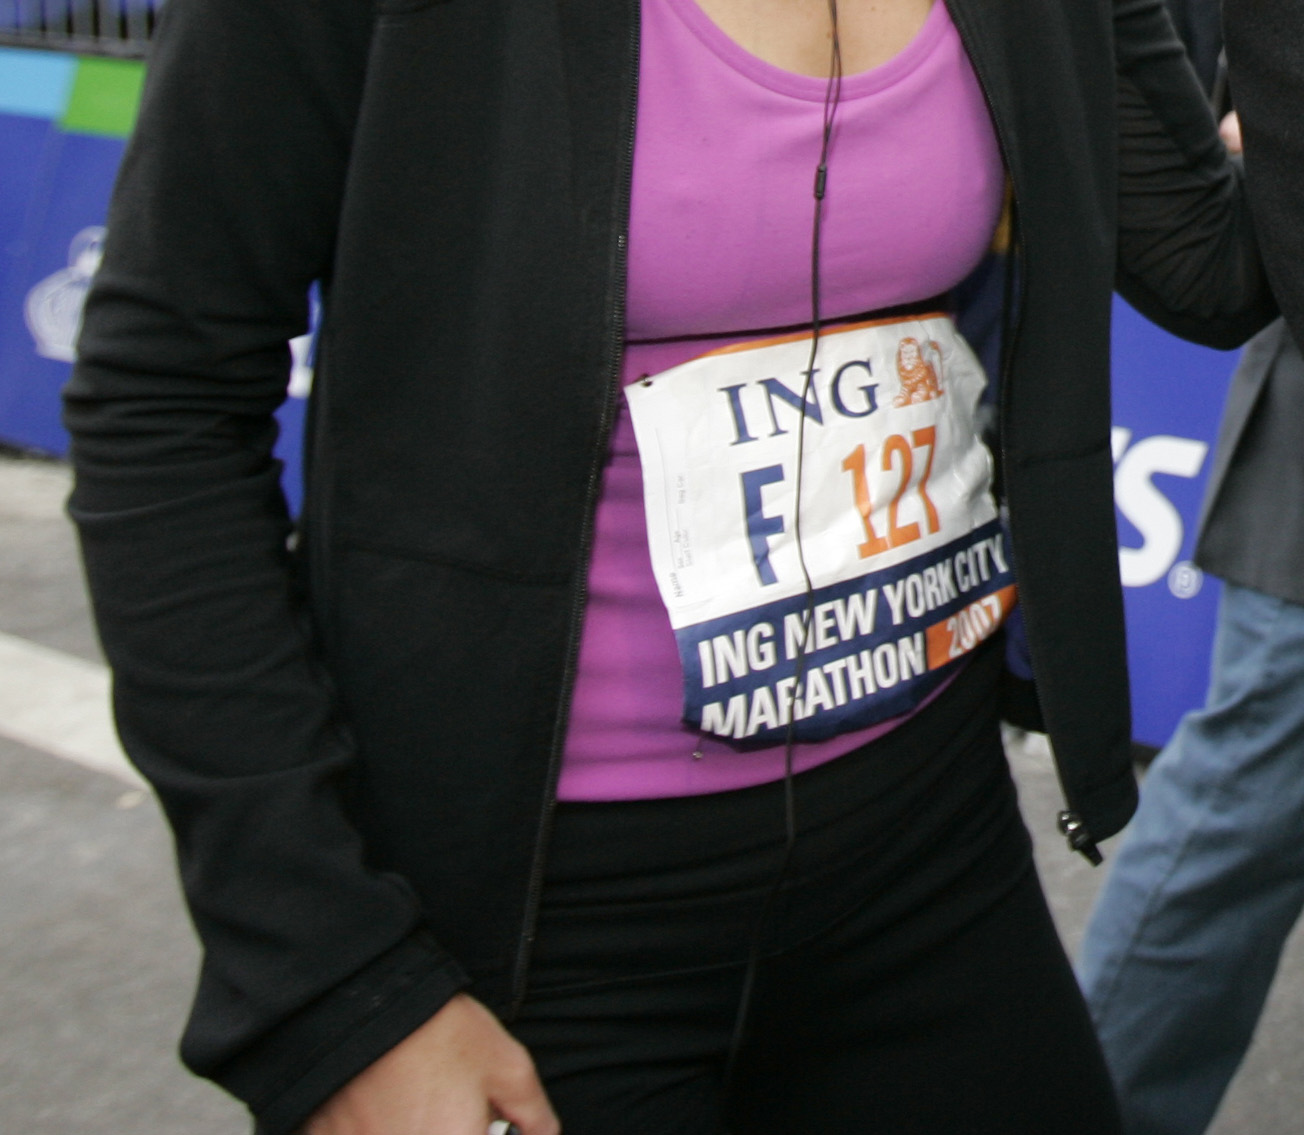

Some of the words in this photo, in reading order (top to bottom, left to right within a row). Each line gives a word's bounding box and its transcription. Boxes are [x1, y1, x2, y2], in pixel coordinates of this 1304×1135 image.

[717, 359, 880, 447] ING
[739, 463, 786, 588] F
[840, 425, 941, 561] 127
[697, 621, 778, 689] ING
[783, 588, 878, 661] NEW
[882, 558, 959, 626] YORK
[954, 532, 1010, 594] CITY
[700, 630, 927, 740] MARATHON
